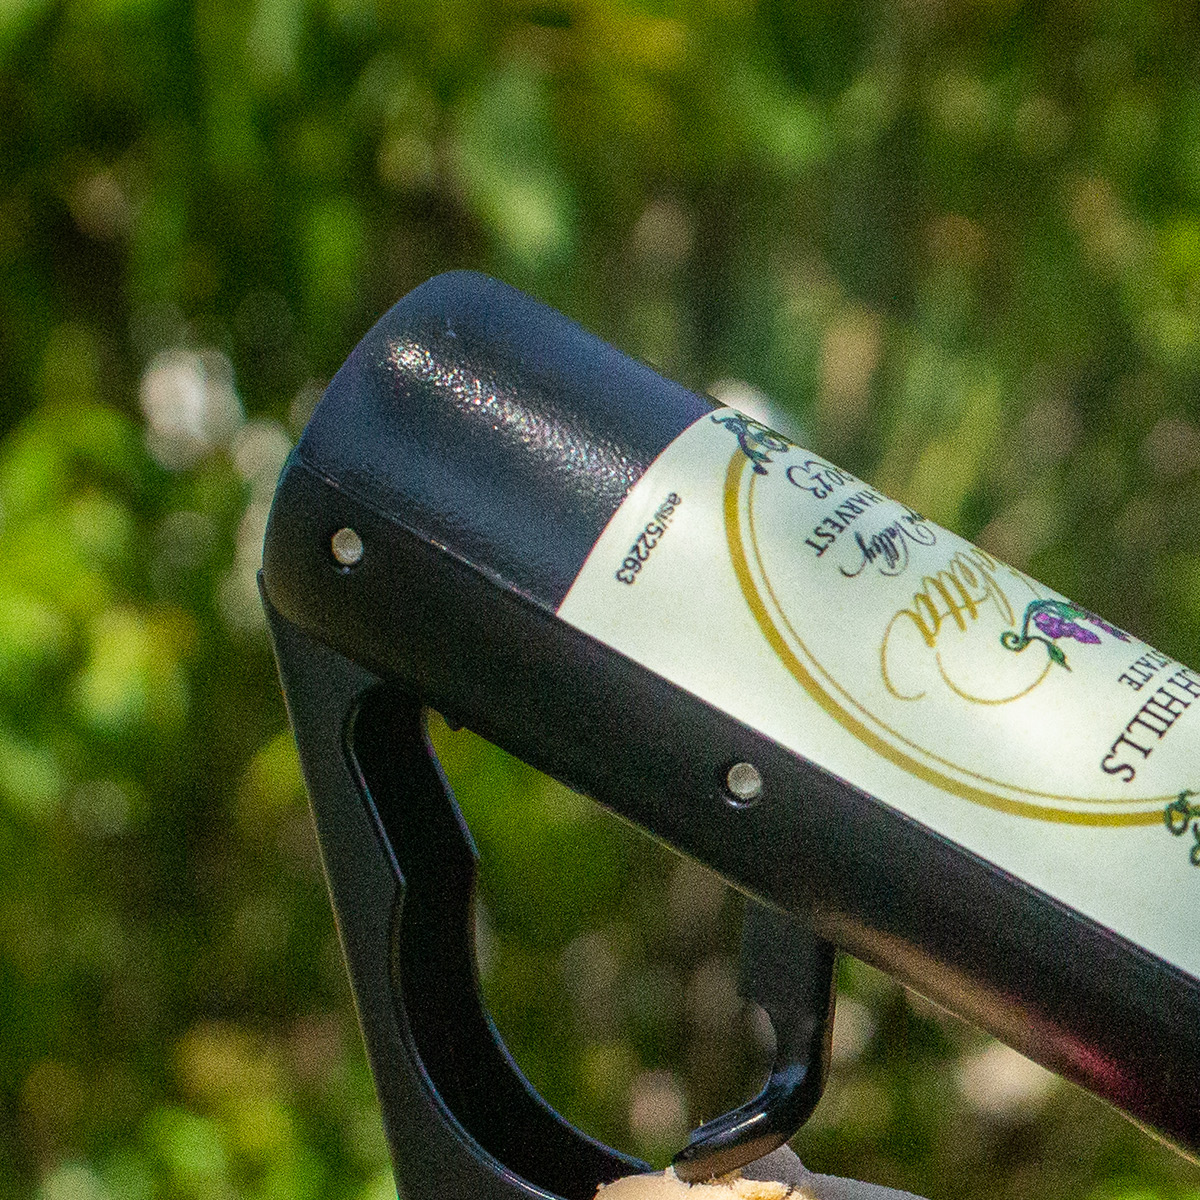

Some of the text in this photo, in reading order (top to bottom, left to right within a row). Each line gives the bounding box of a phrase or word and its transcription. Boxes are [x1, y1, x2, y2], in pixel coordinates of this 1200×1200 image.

[786, 460, 855, 499] 2013
[614, 491, 682, 585] asi/52263
[804, 490, 883, 557] HARVEST
[839, 520, 936, 578] Valley
[1100, 687, 1191, 783] HILLS
